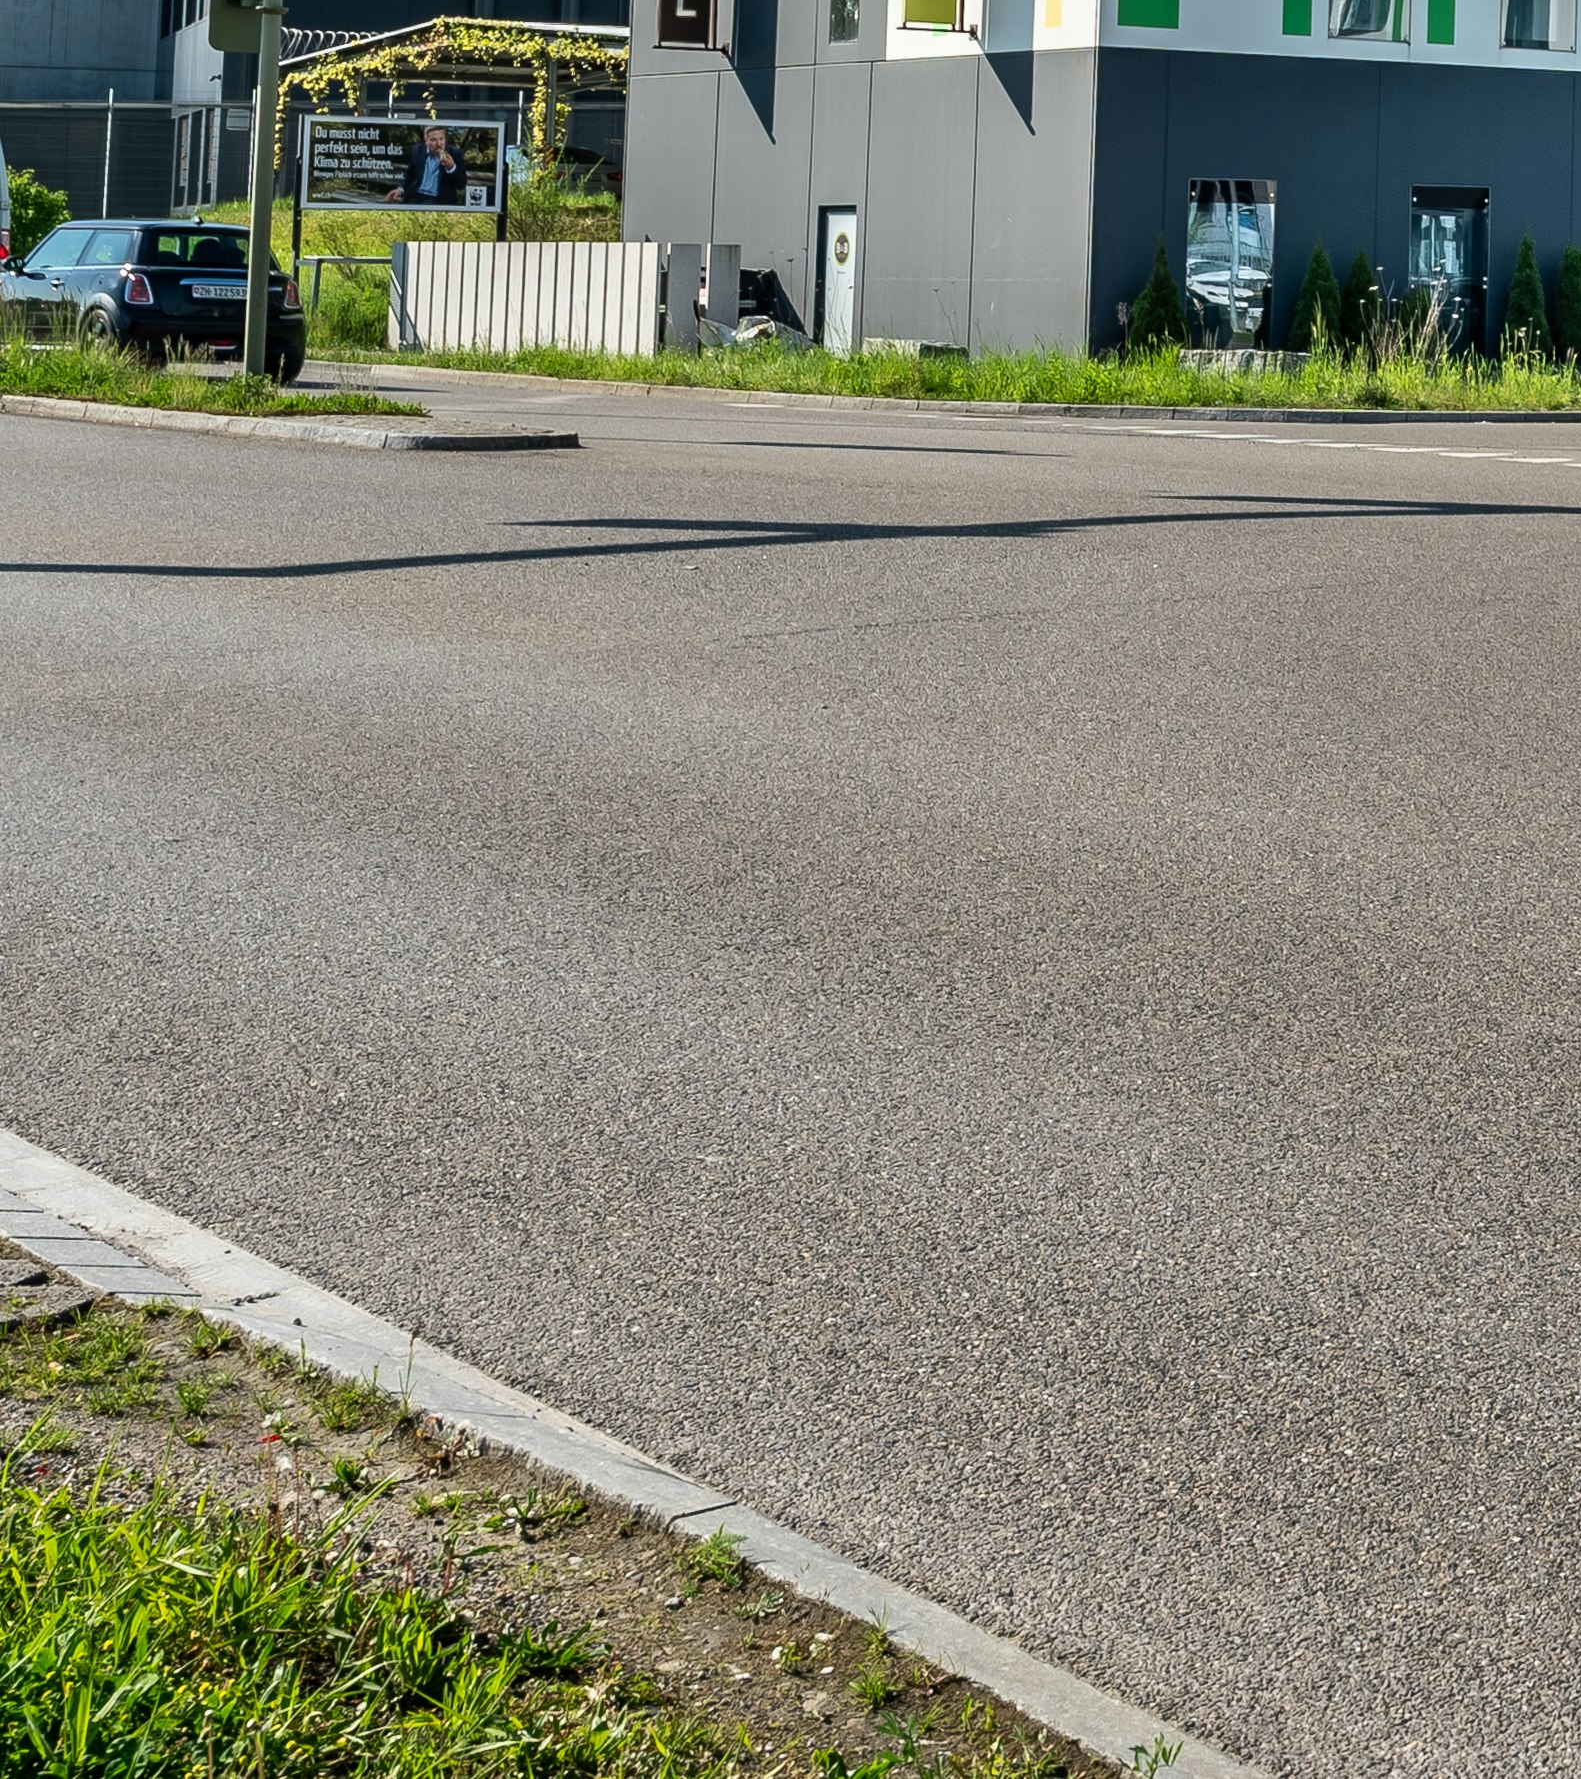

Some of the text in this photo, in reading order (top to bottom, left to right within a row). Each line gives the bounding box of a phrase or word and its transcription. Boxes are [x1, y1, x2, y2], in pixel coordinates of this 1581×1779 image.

[315, 125, 380, 140] Du musst nicht
[314, 141, 403, 156] perfekt sein, um das
[313, 156, 393, 170] Klima zu schützen.
